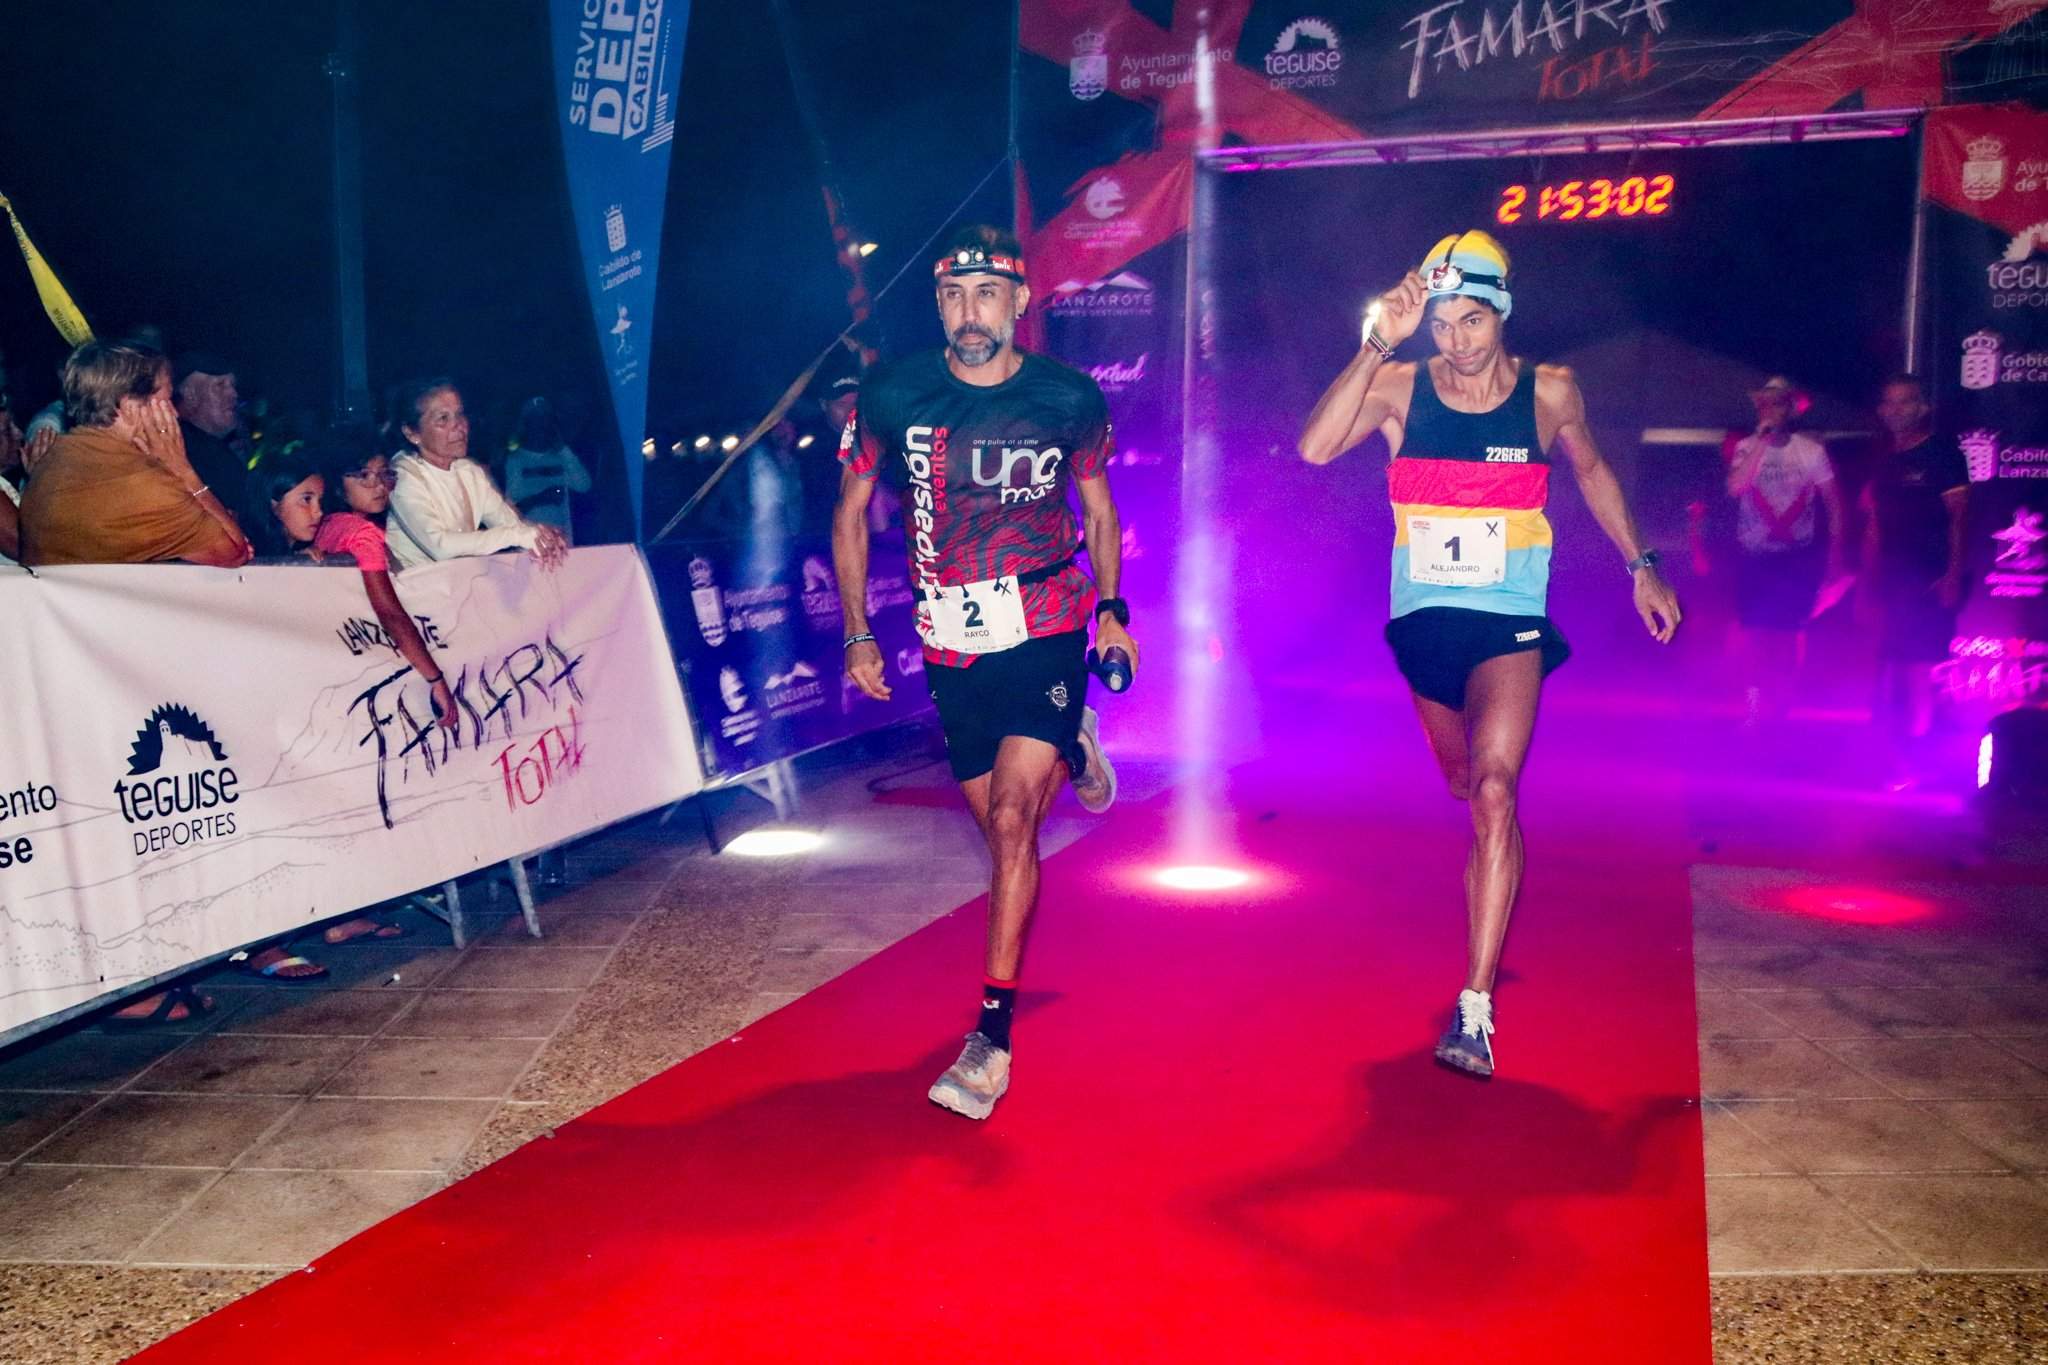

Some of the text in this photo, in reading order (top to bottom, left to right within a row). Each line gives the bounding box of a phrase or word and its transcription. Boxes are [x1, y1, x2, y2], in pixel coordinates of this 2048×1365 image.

[1120, 47, 1232, 74] Ayuntaminto
[1120, 67, 1215, 90] de Tegui
[1270, 73, 1336, 90] DEPORTES
[2015, 179, 2037, 192] de
[1049, 293, 1152, 307] LANZAROTE
[2002, 369, 2022, 382] de
[1486, 447, 1528, 463] 226ERS
[931, 426, 949, 512] eventos
[1444, 536, 1460, 561] 1
[1431, 563, 1480, 573] ALEJANDRO
[962, 601, 984, 628] 2
[336, 615, 448, 658] LANZATE
[964, 629, 990, 638] RAYCO
[133, 812, 237, 856] DEPORTES
[0, 837, 33, 869] se
